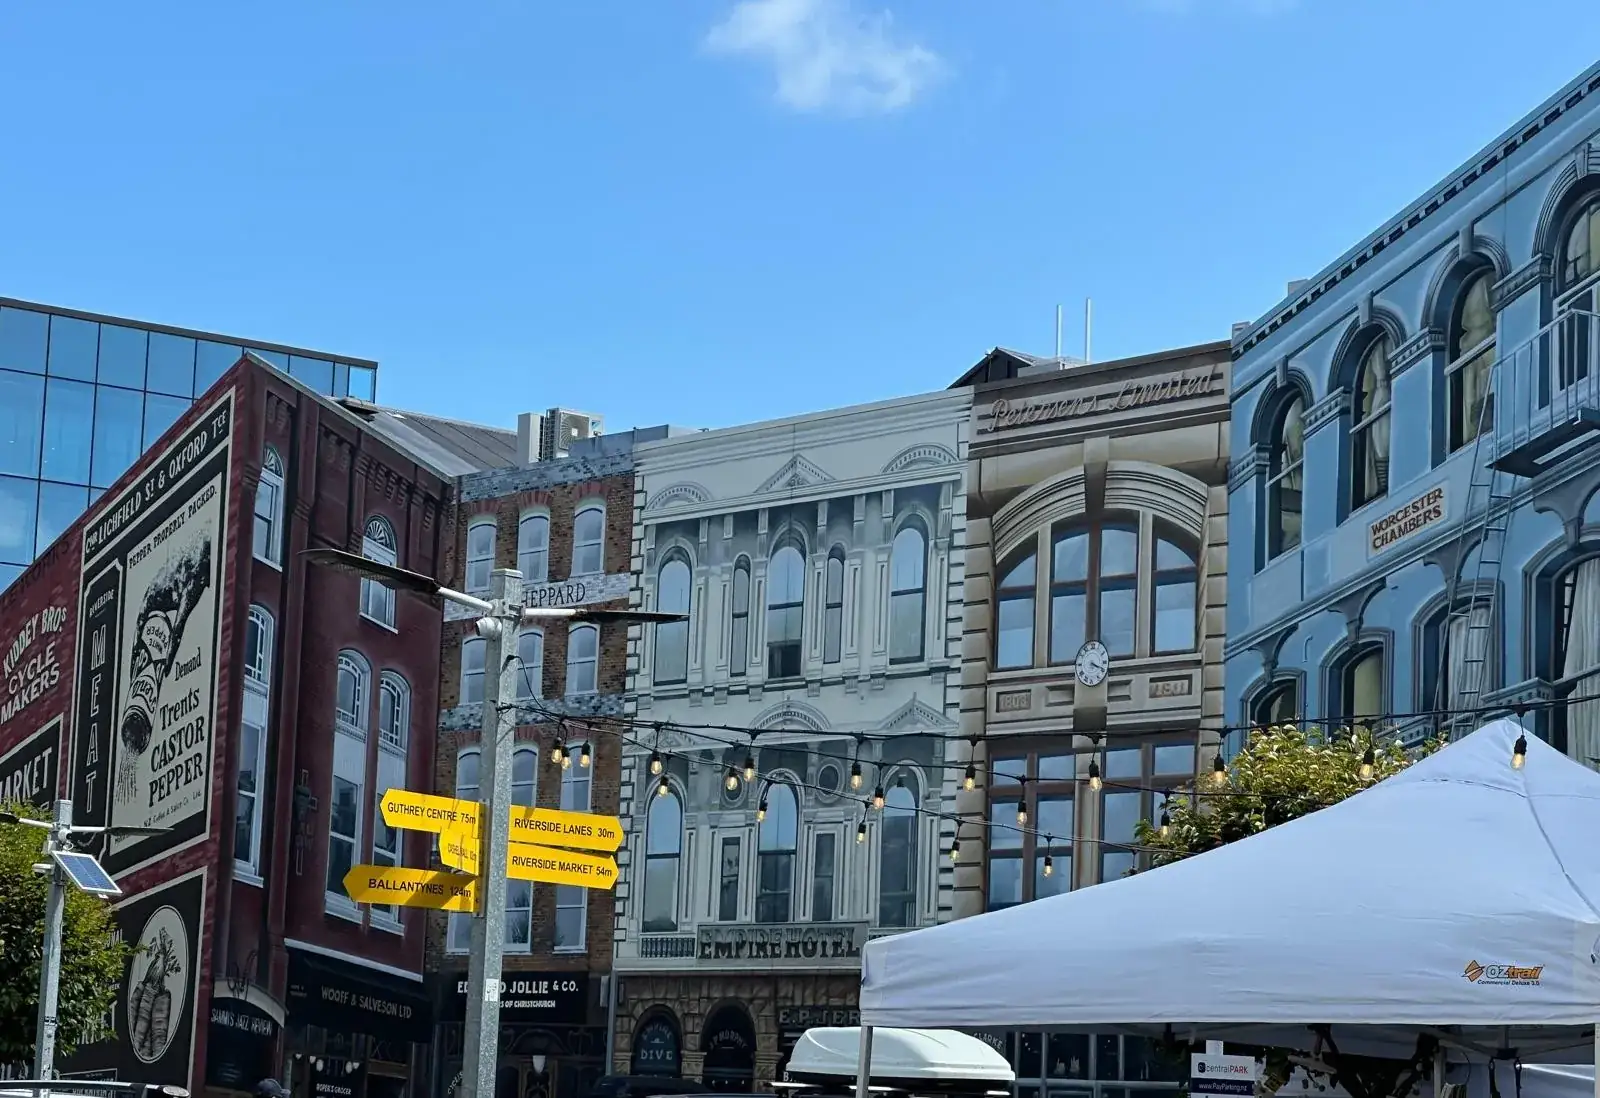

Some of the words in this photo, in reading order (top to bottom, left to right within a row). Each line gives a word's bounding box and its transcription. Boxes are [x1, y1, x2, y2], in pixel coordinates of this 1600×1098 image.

[1108, 363, 1217, 410] Limited
[98, 491, 142, 544] LICHFIELD
[158, 470, 166, 488] &
[169, 430, 208, 478] OXFORD
[129, 543, 152, 569] PEPPER
[153, 511, 186, 548] PROPERLY
[188, 485, 217, 519] PACKED.
[1371, 487, 1444, 536] WORCESTER
[1373, 505, 1442, 549] CHAMBERS
[89, 589, 115, 618] RIVERSIDE
[3, 613, 39, 679] KIDDEY
[174, 646, 202, 681] Demand
[8, 641, 56, 695] CYCLE
[0, 662, 60, 725] MAKERS
[160, 687, 200, 731] Trents
[85, 624, 106, 814] MEAT
[150, 716, 205, 773] CASTOR
[149, 752, 204, 808] PEPPER
[387, 802, 425, 817] GUTHREY
[426, 808, 457, 822] CENTRE
[461, 813, 476, 824] 75m
[514, 818, 562, 833] RIVERSIDE
[563, 824, 592, 836] LANES
[598, 827, 615, 839] 30m
[512, 855, 557, 871] RIVERSIDE
[558, 861, 593, 875] MARKET
[596, 866, 612, 877] 54m
[368, 878, 444, 895] BALLANTYNES
[450, 885, 472, 898] 124m
[698, 927, 783, 960] EMPIRE
[784, 927, 861, 959] HOTEL
[321, 984, 349, 1005] WOOFF
[350, 993, 357, 1006] &
[359, 995, 398, 1017] SALVESON
[398, 1003, 412, 1019] LTD
[505, 1000, 513, 1009] OF
[514, 1000, 556, 1009] CHRISTCHURCH
[509, 981, 549, 995] JOLLIE
[552, 980, 559, 991] &
[561, 980, 579, 992] CO.
[235, 1013, 249, 1031] JAZZ
[640, 1048, 673, 1061] DIVE
